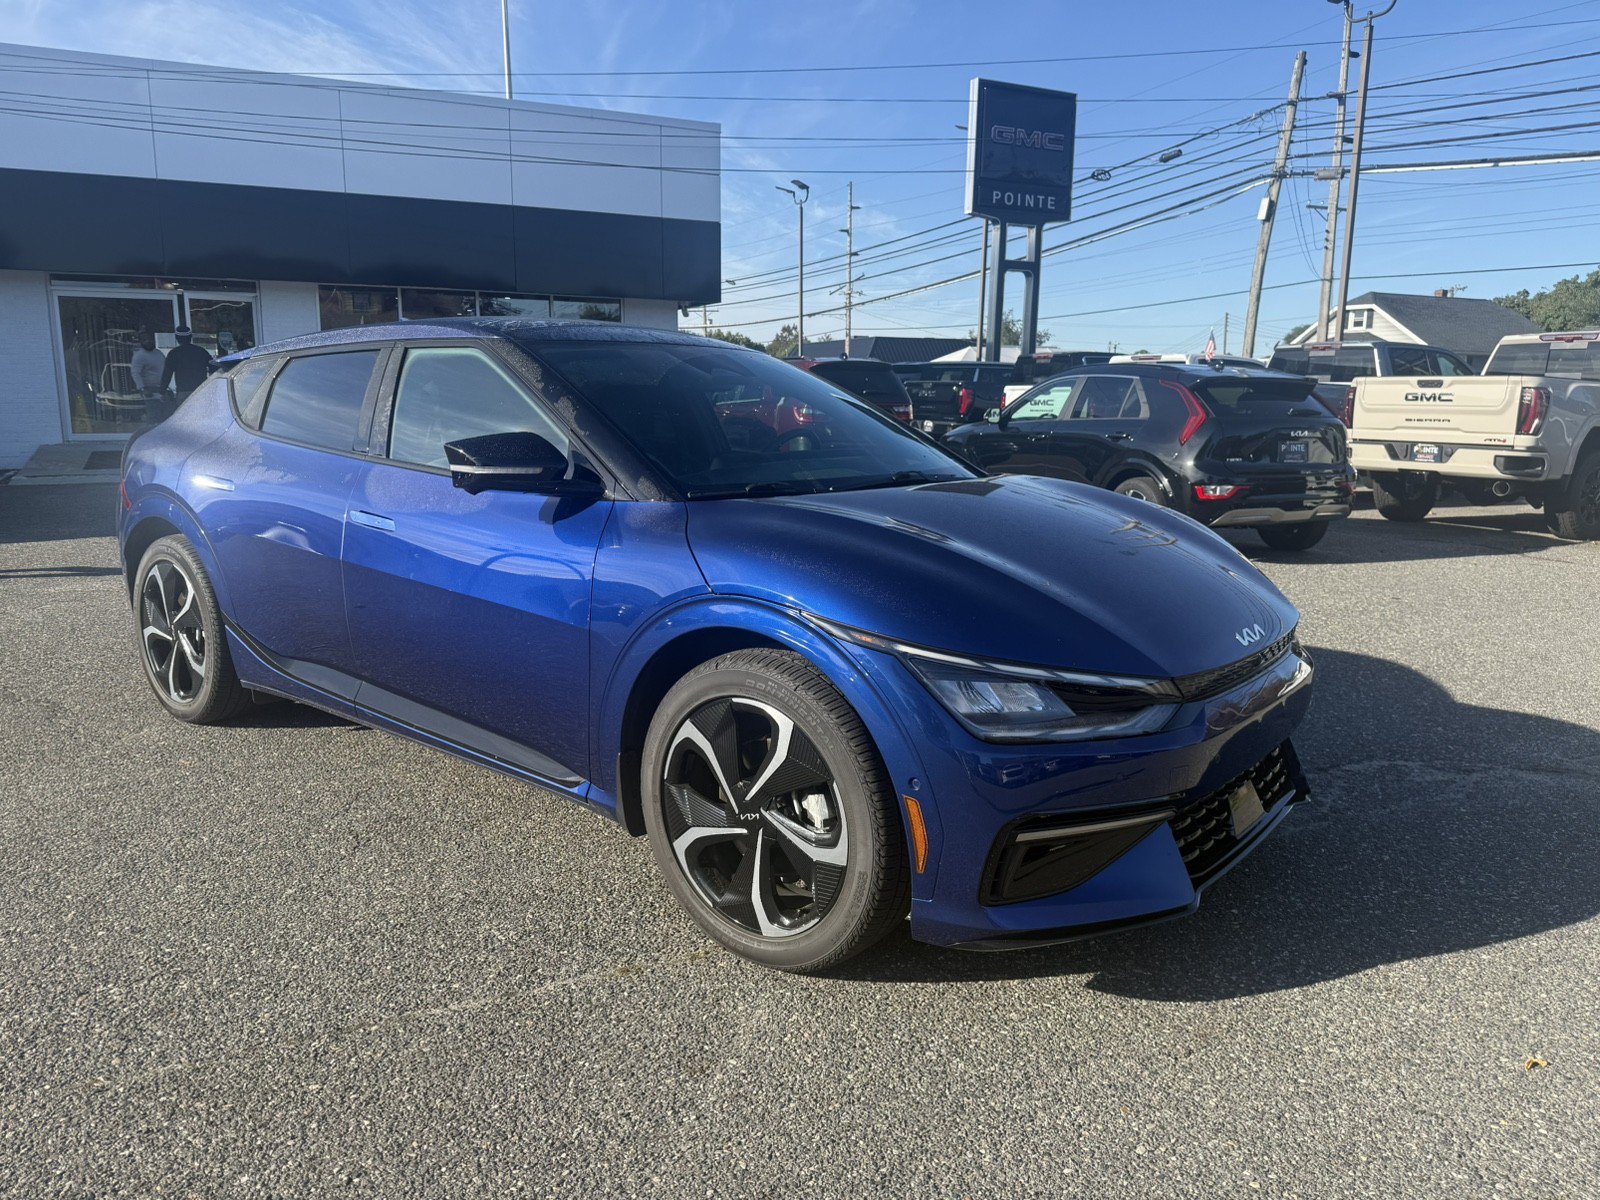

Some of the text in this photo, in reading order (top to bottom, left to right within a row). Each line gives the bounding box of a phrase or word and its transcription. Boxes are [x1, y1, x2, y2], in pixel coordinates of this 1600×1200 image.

[991, 125, 1065, 151] GMC
[992, 191, 1056, 209] POINTE
[1404, 392, 1454, 402] GMC
[1235, 623, 1266, 647] KIA
